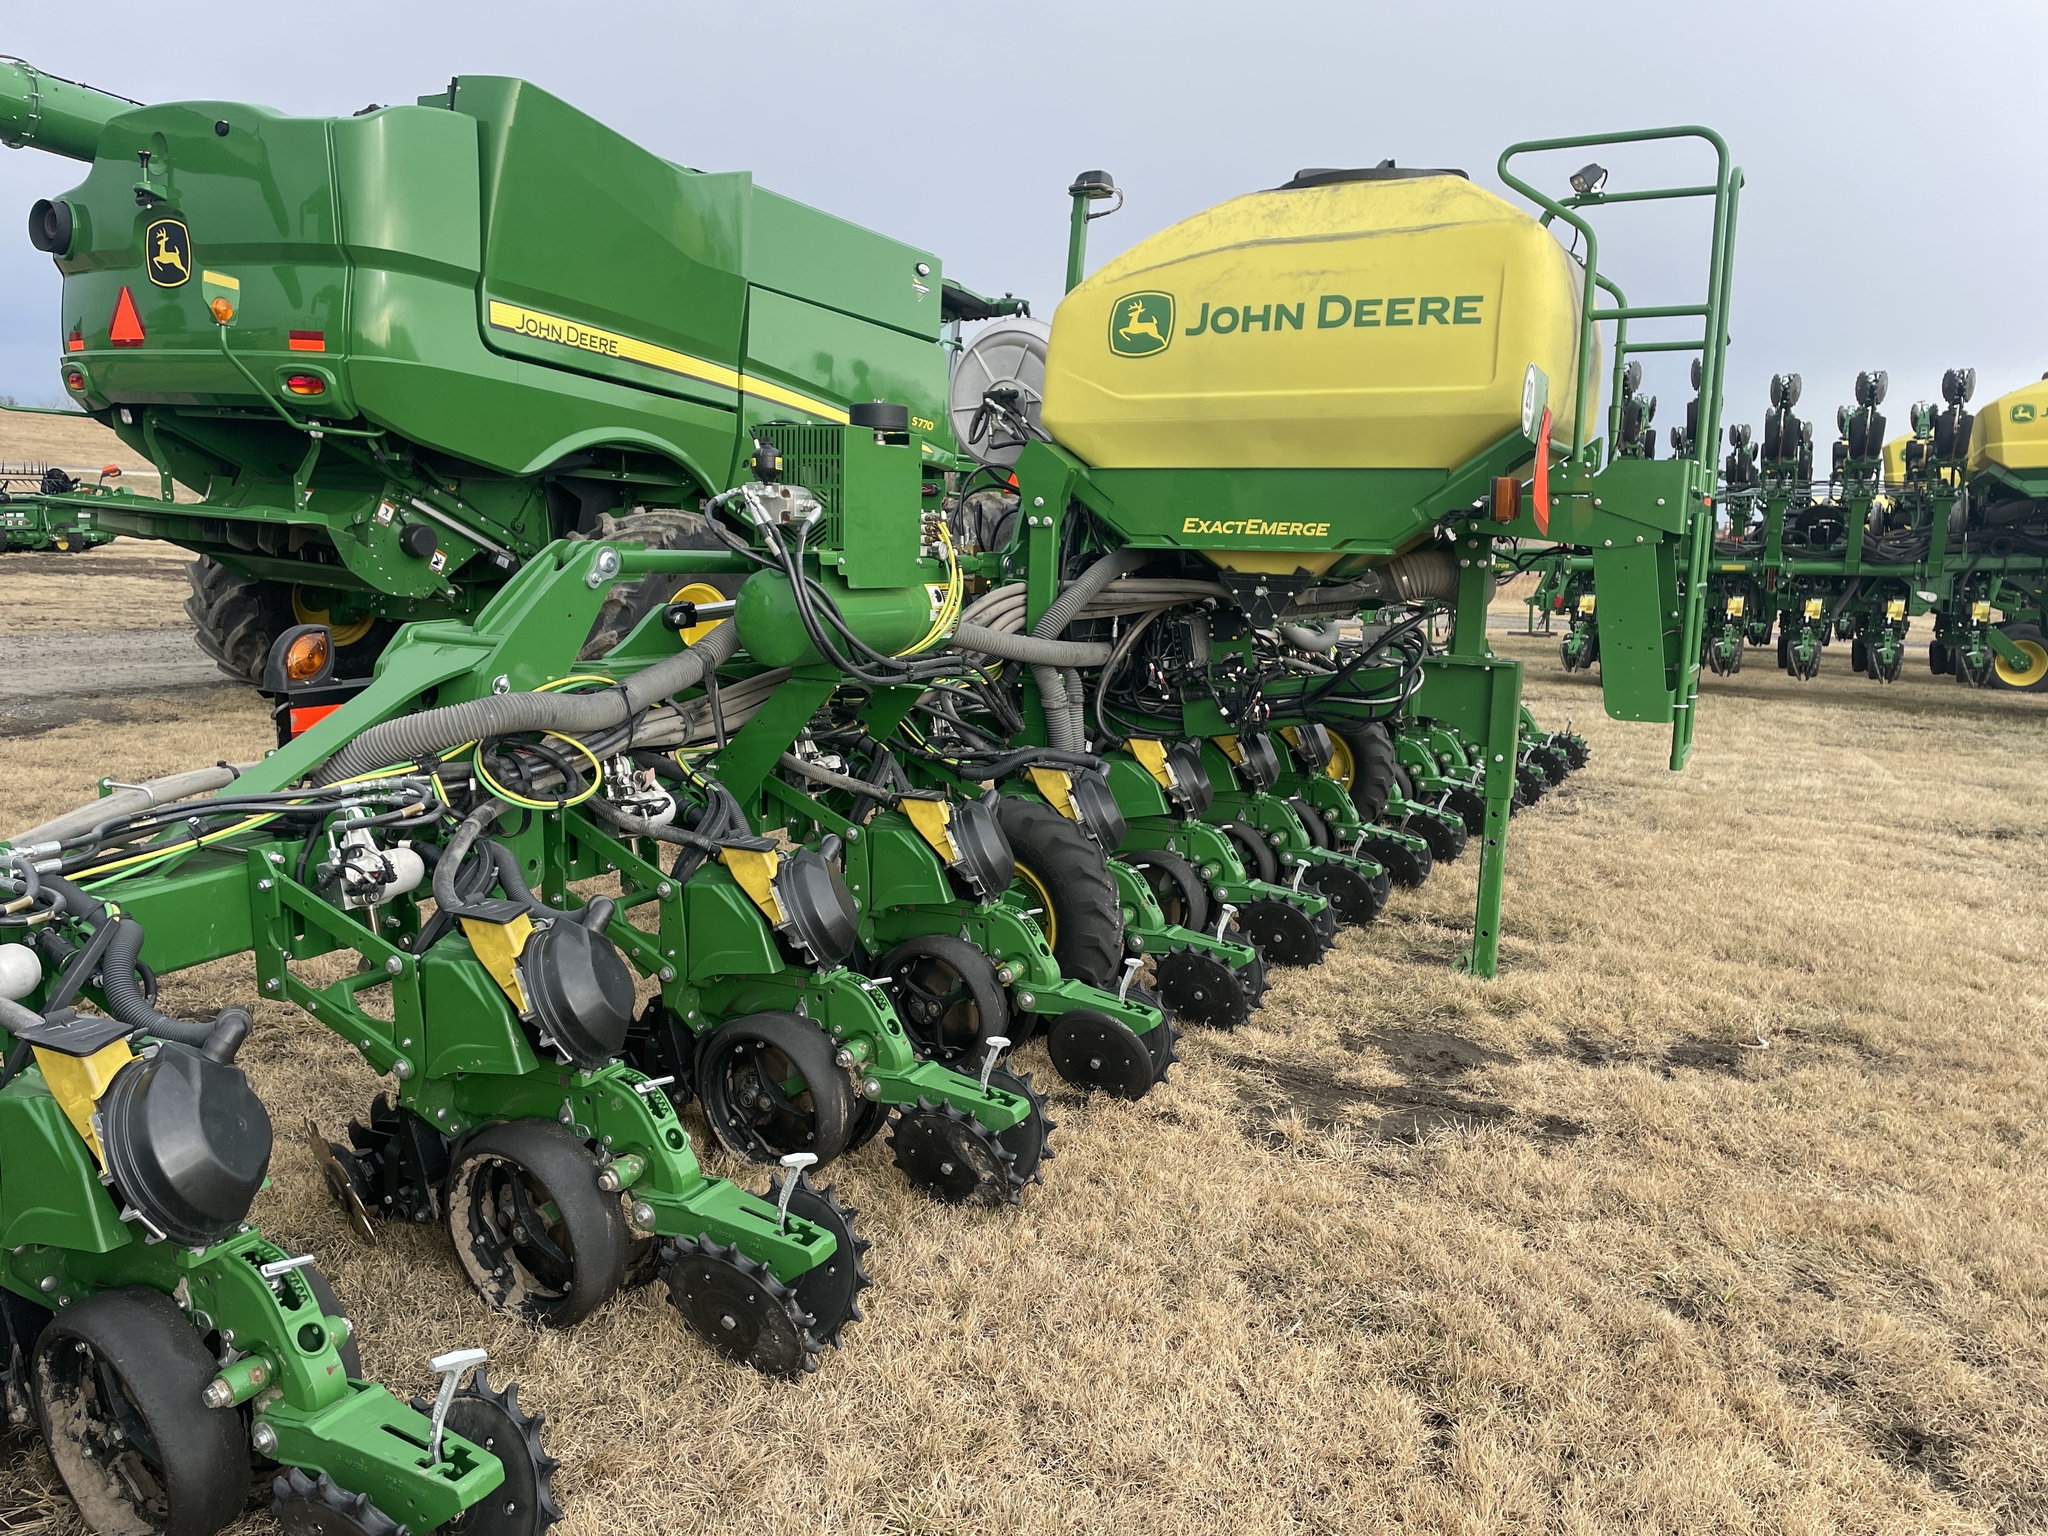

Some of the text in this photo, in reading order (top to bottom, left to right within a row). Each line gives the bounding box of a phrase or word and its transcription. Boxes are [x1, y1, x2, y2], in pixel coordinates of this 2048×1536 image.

[515, 313, 618, 354] JOHN DEERE
[1185, 295, 1484, 336] JOHN DEERE
[911, 416, 934, 431] S770
